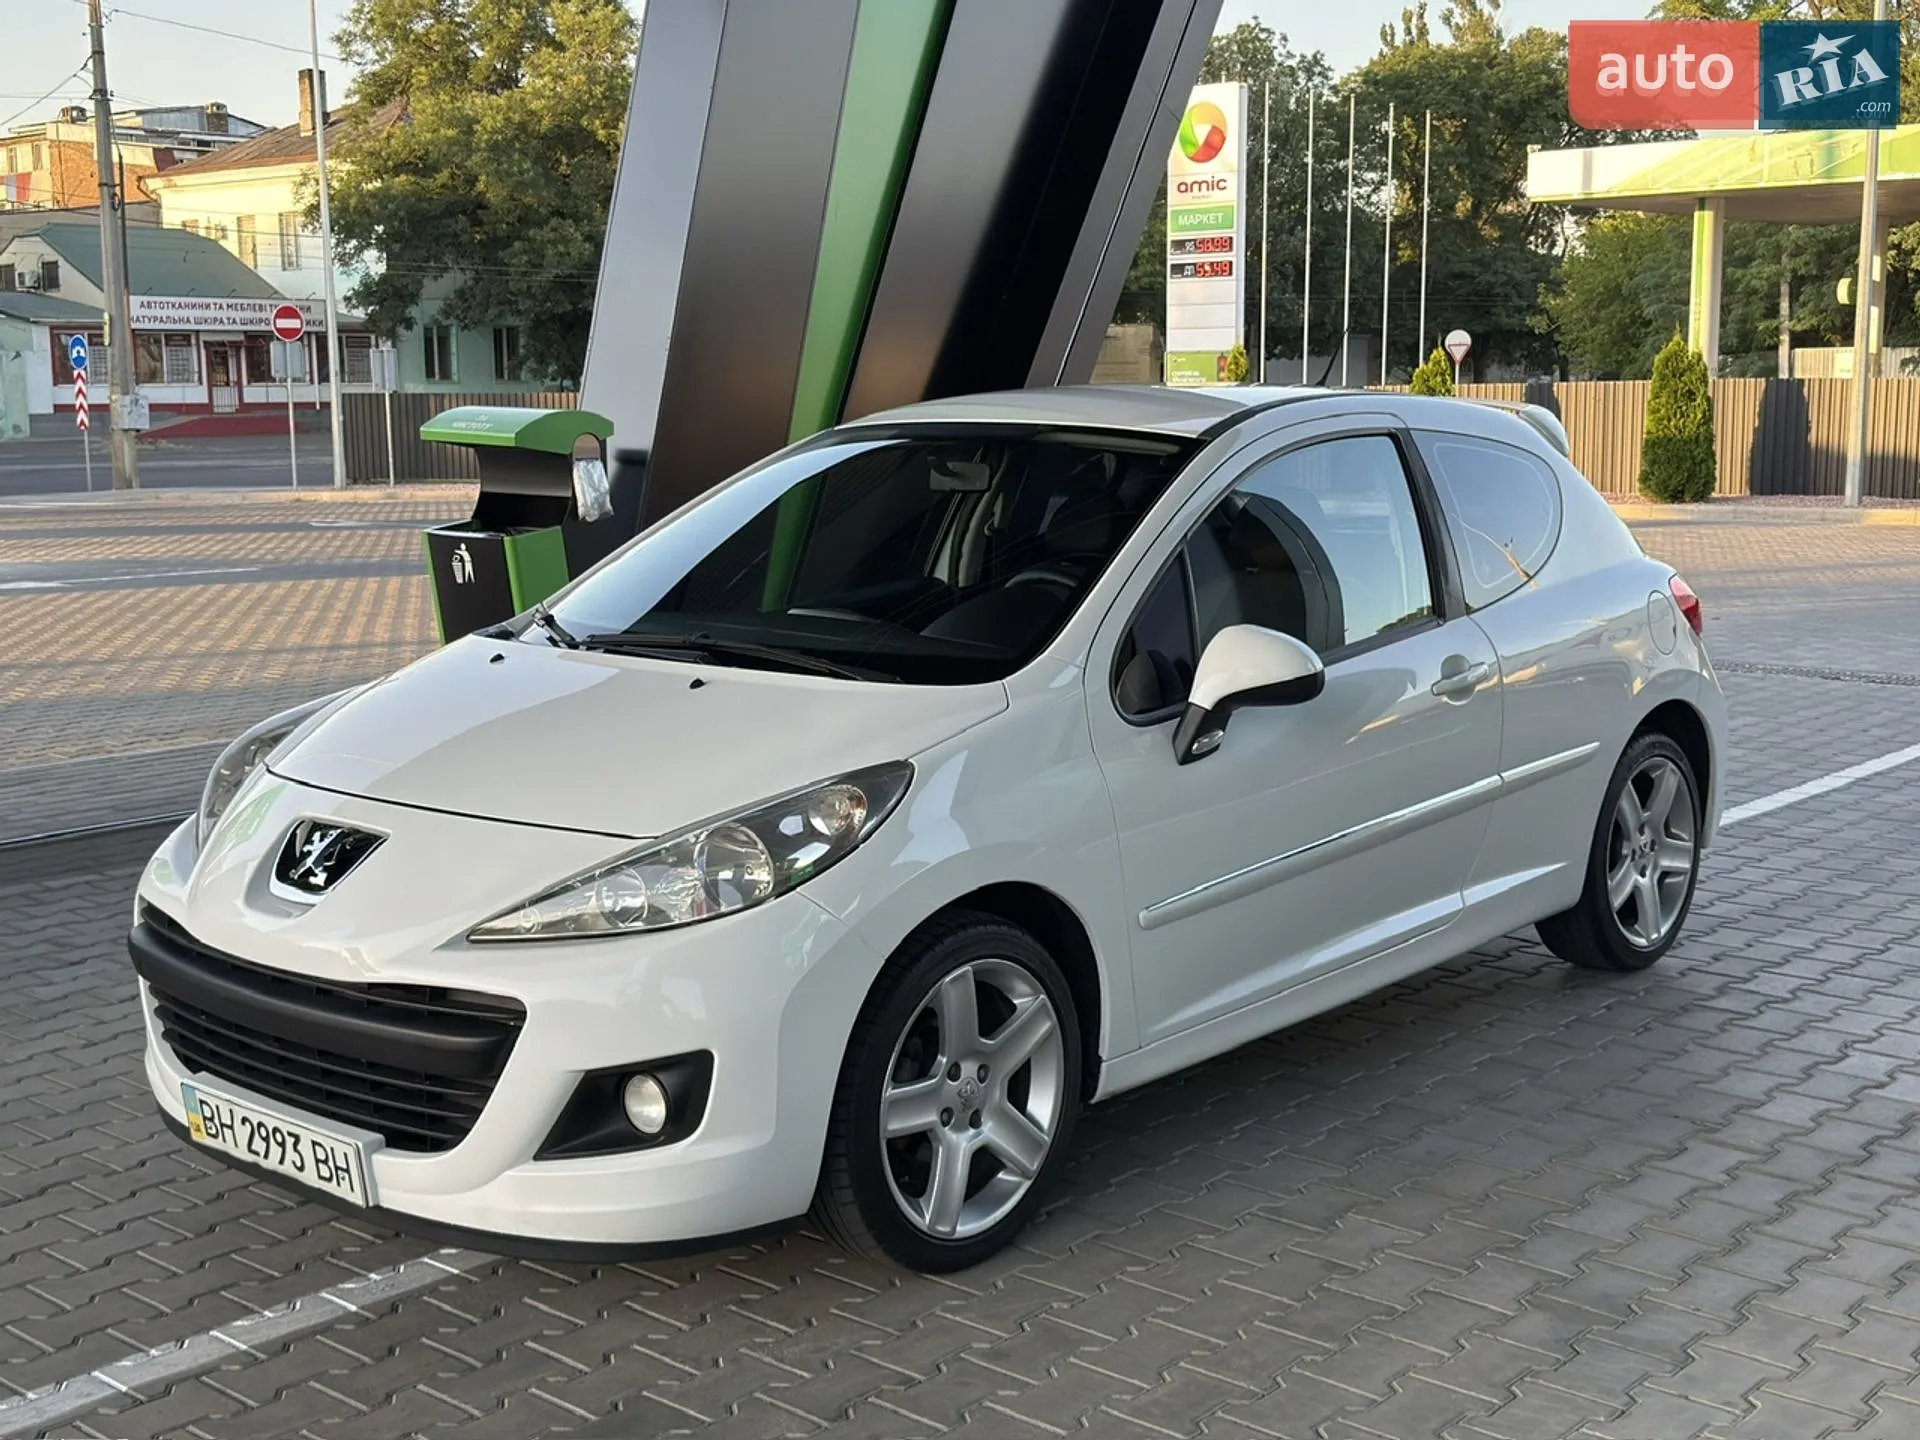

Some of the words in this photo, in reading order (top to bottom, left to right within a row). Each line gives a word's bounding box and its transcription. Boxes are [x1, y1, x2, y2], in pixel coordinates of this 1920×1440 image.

[1177, 175, 1227, 193] amic
[1178, 212, 1224, 225] МАРКЕТ
[140, 301, 211, 311] АВТОТКАНИНИ
[213, 303, 224, 311] ТА
[226, 303, 268, 313] МЕБЛЕВІ
[194, 317, 225, 326] ШКІРА
[226, 317, 238, 326] ТА
[241, 1116, 305, 1173] 2993
